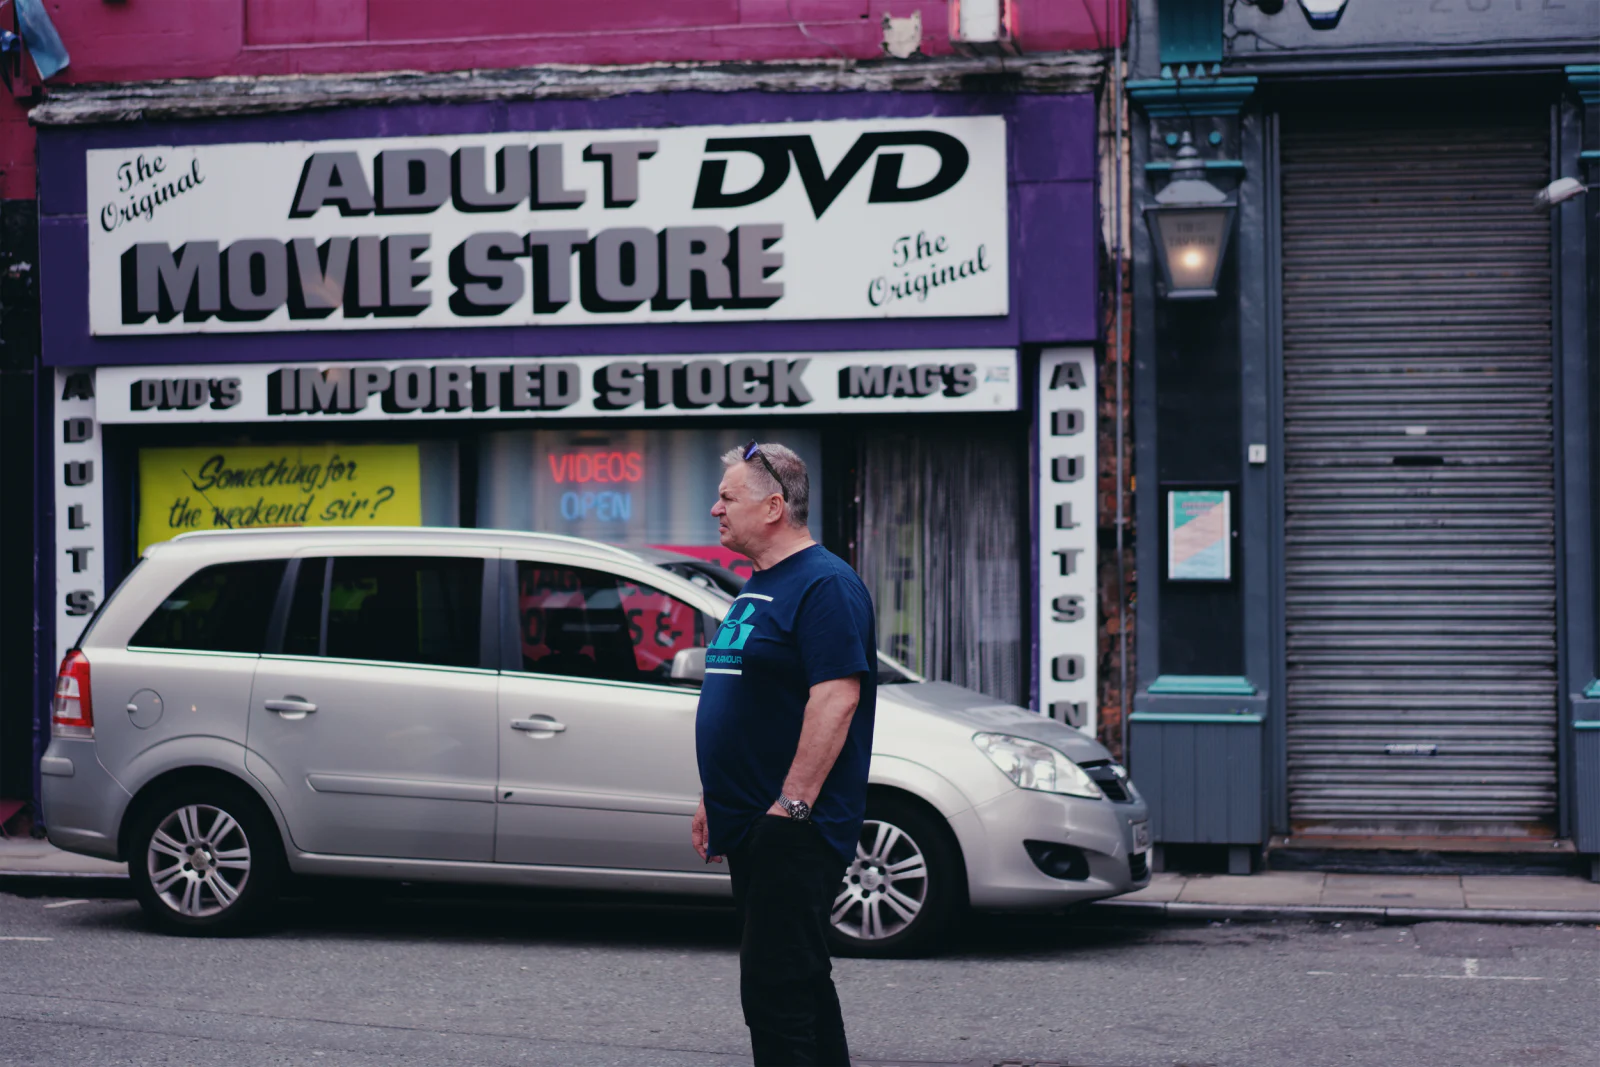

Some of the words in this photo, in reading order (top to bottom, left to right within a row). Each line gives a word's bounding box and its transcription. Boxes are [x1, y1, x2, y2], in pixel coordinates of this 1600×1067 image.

[100, 157, 206, 233] Original
[117, 153, 167, 193] The
[288, 140, 660, 219] ADULT
[692, 130, 969, 220] DVD
[121, 233, 432, 326] MOVIE
[448, 223, 785, 317] STORE
[892, 230, 949, 268] The
[867, 243, 991, 307] Original
[130, 377, 242, 411] DVD'S
[267, 363, 581, 416] IMPORTED
[592, 357, 814, 410] STOCK
[838, 362, 977, 399] MAG'S
[192, 454, 322, 493] Something
[317, 453, 357, 489] for
[548, 451, 642, 484] VIDEOS
[1048, 361, 1087, 624] ADULTS
[61, 373, 95, 616] ADULTS
[168, 497, 202, 528] the
[320, 485, 395, 521] sir?
[561, 491, 632, 521] OPEN
[716, 655, 743, 665] ARMOUR
